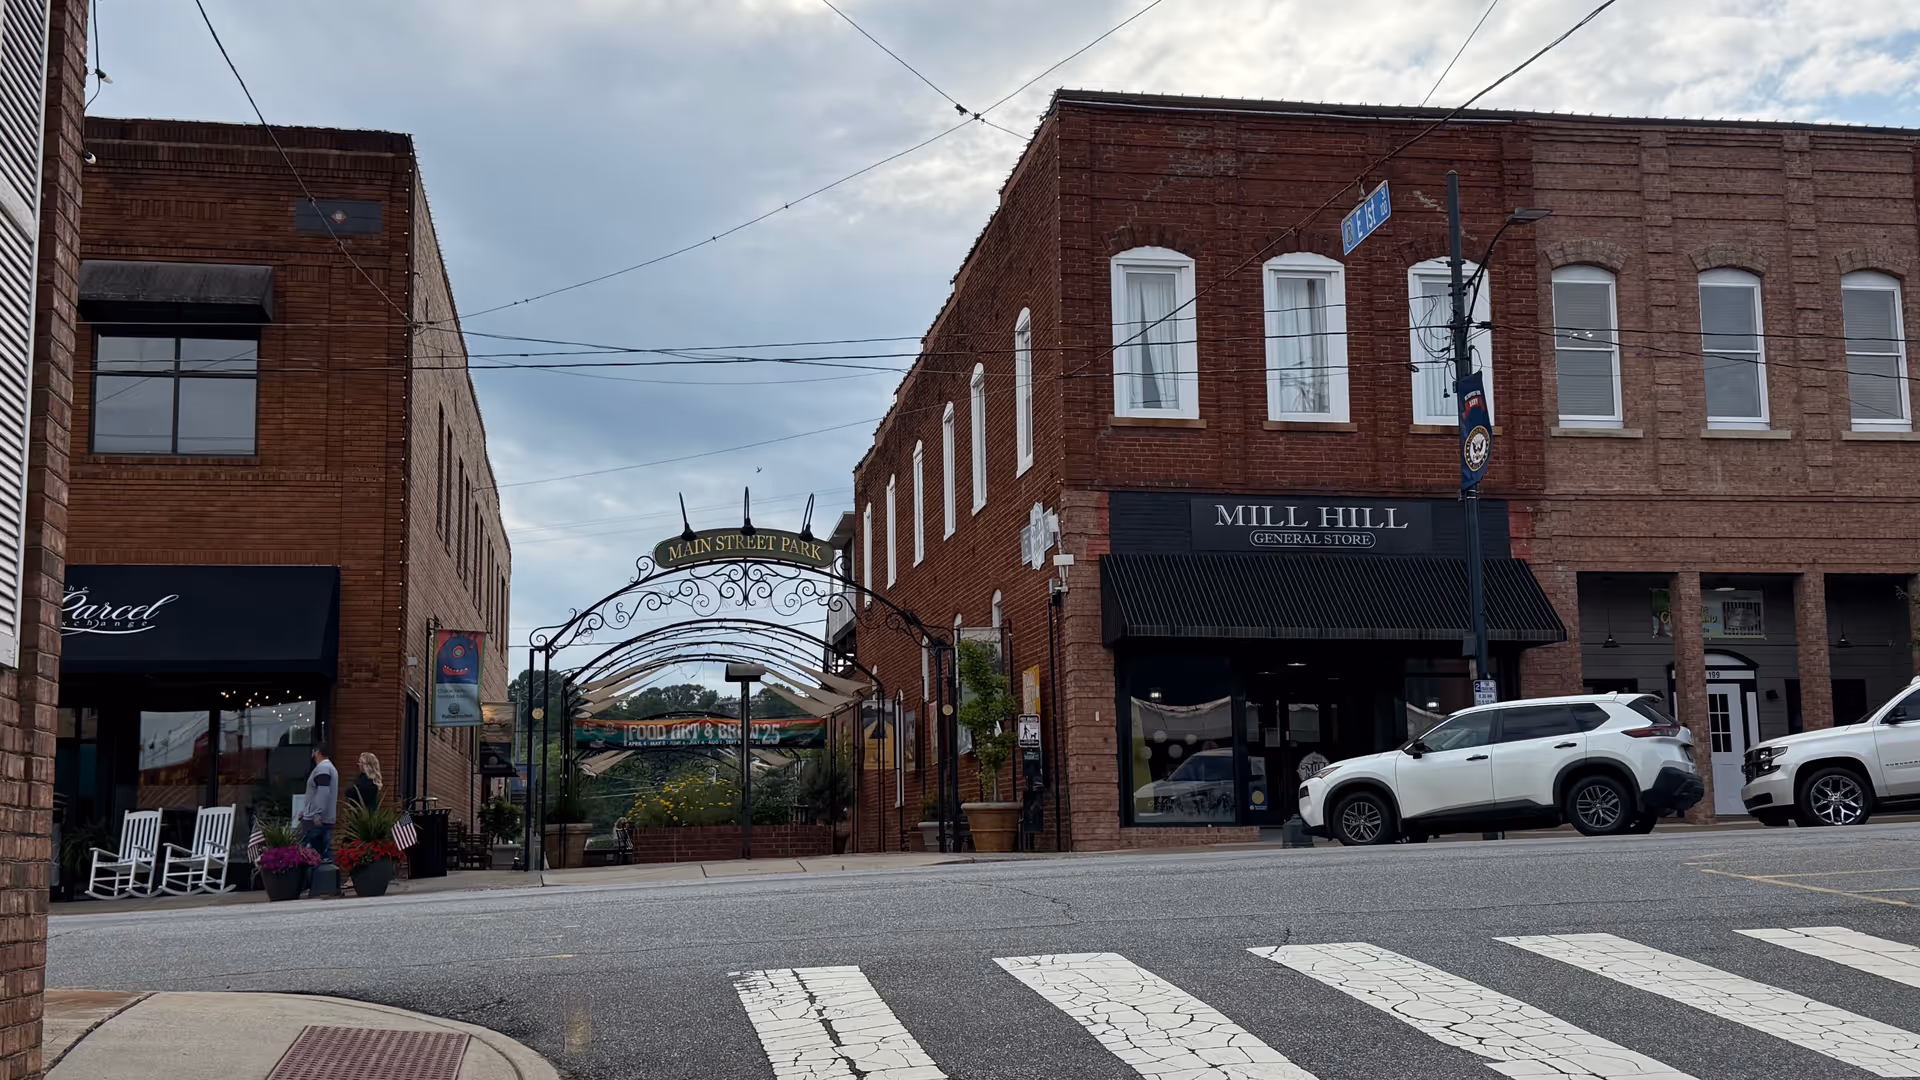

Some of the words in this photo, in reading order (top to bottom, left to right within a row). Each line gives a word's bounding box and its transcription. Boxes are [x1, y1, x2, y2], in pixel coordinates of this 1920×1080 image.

[1356, 210, 1364, 239] E
[1214, 504, 1309, 528] MILL
[1317, 506, 1409, 529] HILL
[668, 536, 712, 561] MAIN
[715, 534, 776, 550] STREET
[781, 536, 822, 561] PARK
[1254, 533, 1321, 545] GENERAL
[1324, 533, 1371, 545] STORE
[61, 620, 147, 628] xchange
[629, 724, 667, 740] FOOD
[670, 722, 700, 740] ART
[704, 722, 714, 739] &
